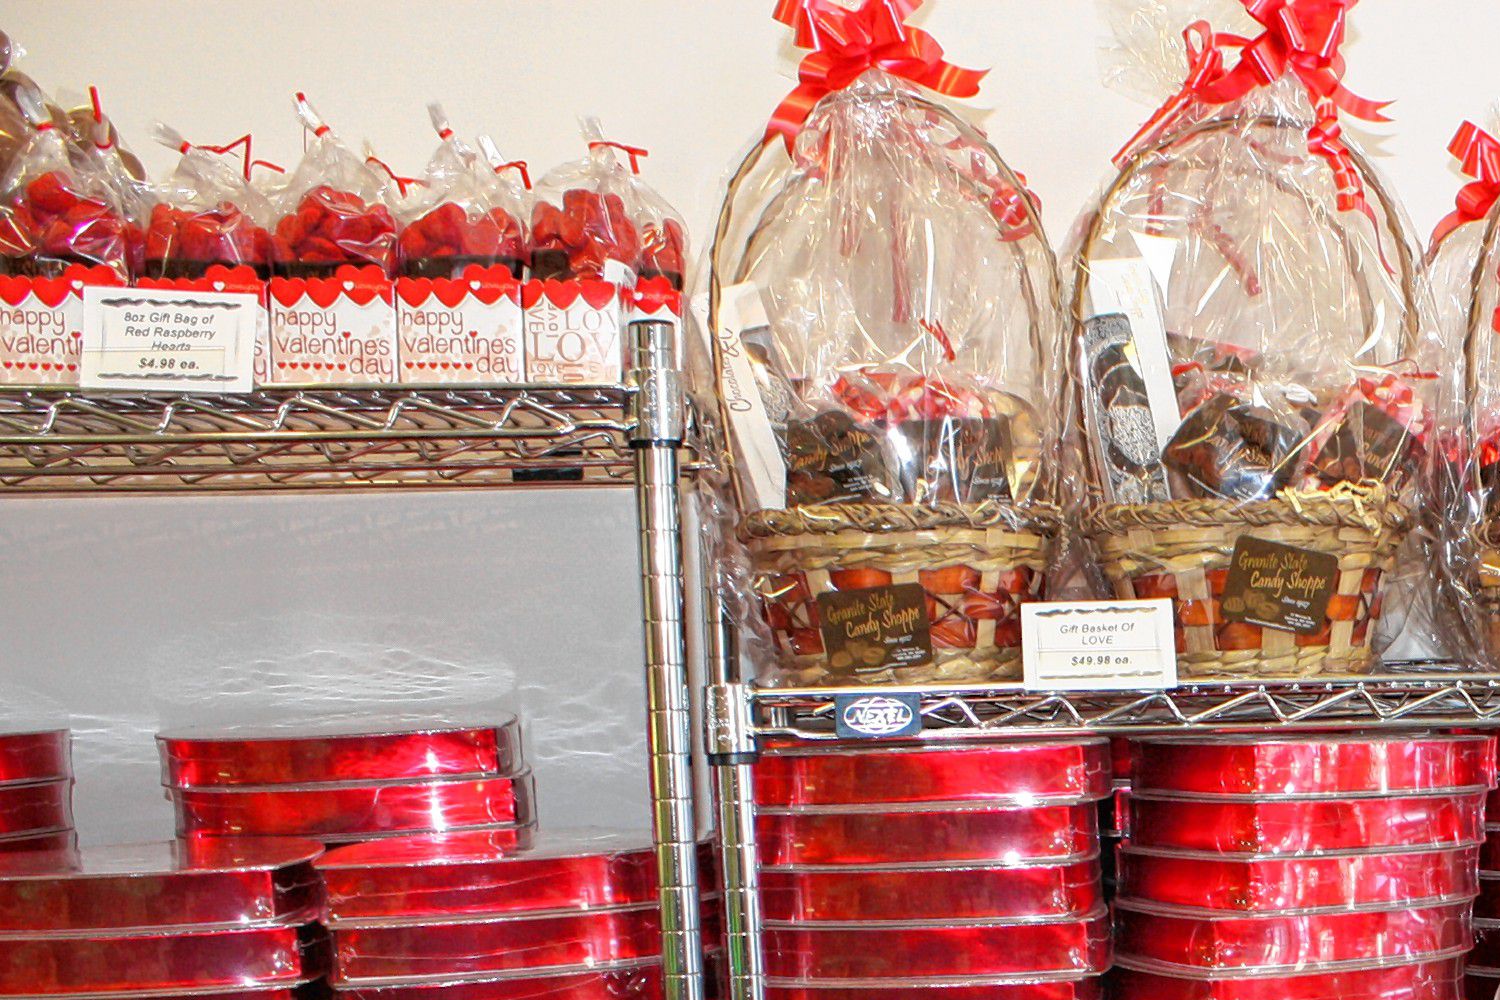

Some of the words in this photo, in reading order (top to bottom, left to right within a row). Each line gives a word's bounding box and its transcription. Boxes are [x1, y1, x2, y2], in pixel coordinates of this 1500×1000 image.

[0, 309, 66, 336] happy
[124, 311, 145, 323] 8oz
[149, 312, 171, 323] Gift
[174, 313, 198, 327] Bag
[201, 314, 215, 325] of
[275, 310, 337, 337] happy
[402, 310, 464, 337] happy
[125, 326, 152, 338] Red
[154, 327, 217, 341] Raspberry
[2, 333, 84, 357] valenti
[151, 341, 192, 352] Hearts
[138, 357, 177, 371] $4.98
[350, 355, 394, 384] day
[476, 355, 520, 384] day
[1239, 550, 1279, 571] Granite
[1280, 552, 1308, 571] State
[1250, 566, 1284, 598] Candy
[1286, 569, 1326, 599] Shoppe
[826, 599, 866, 626] Granite
[868, 589, 894, 612] State
[845, 611, 881, 642] Candy
[882, 605, 920, 634] Shoppe
[1060, 624, 1079, 634] Gift
[1081, 623, 1118, 634] Basket
[1121, 622, 1136, 632] Of
[1081, 635, 1114, 646] LOVE
[1071, 655, 1111, 667] $49.98
[849, 707, 909, 726] NEXEL
